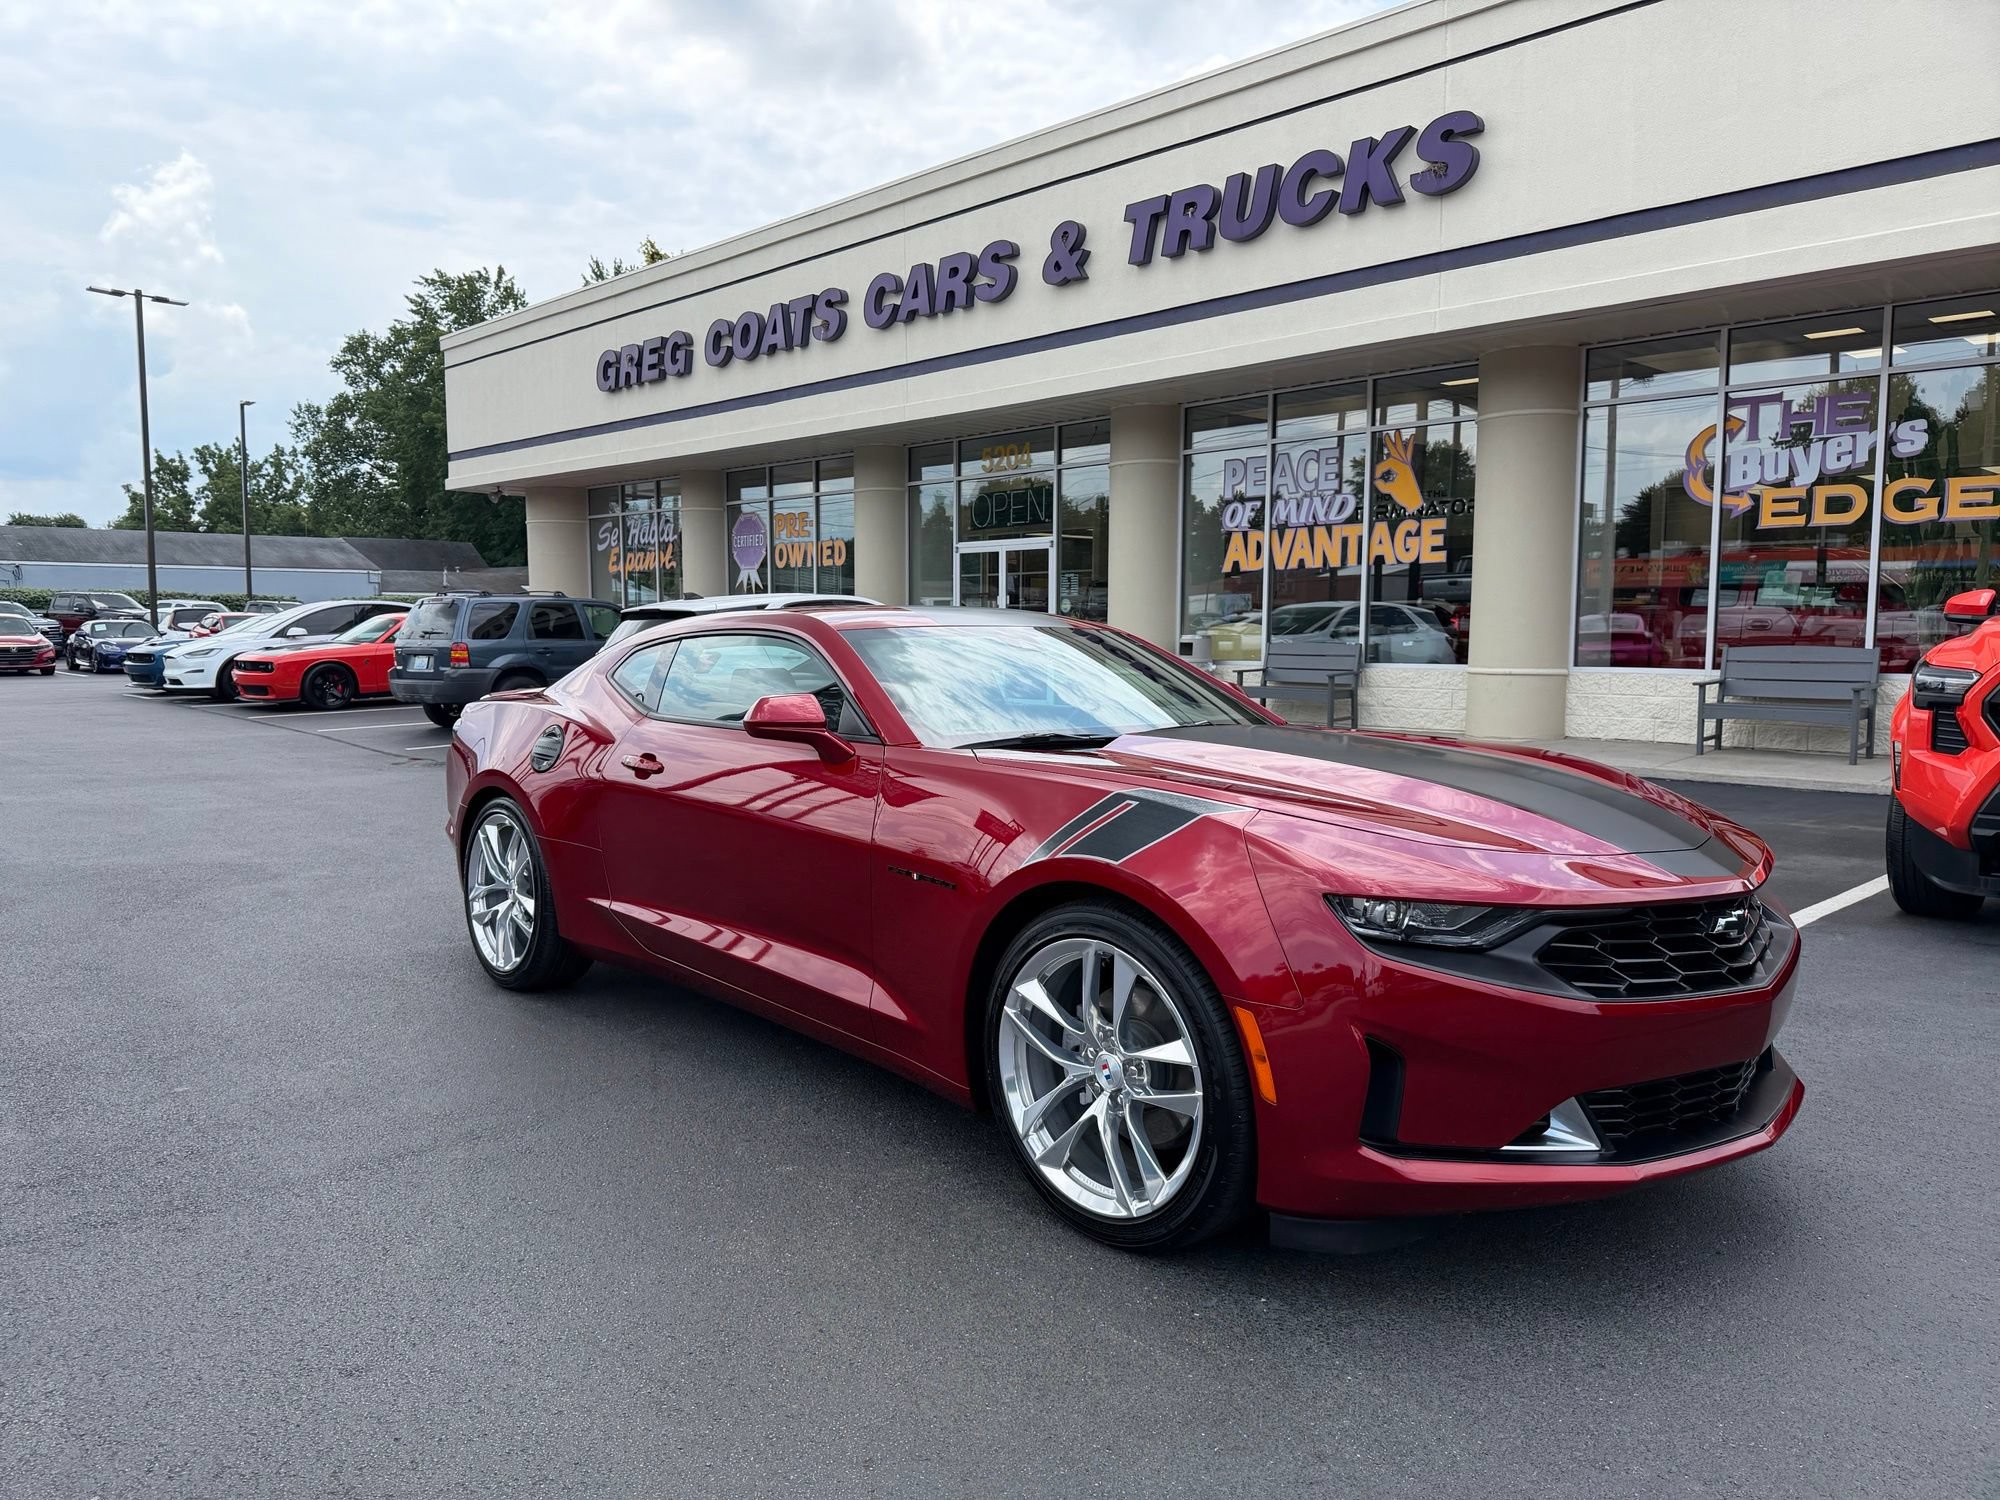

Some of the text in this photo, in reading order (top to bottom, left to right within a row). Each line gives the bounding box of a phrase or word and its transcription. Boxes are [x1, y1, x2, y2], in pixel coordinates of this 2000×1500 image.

[597, 110, 1485, 392] GREG COATS CARS & TRUCKS
[1727, 390, 1872, 444] THE
[981, 442, 1032, 473] 5204
[1223, 447, 1340, 500] PEACE
[1726, 418, 1929, 492] Buyer's
[972, 487, 1046, 528] OPEN
[1222, 494, 1357, 531] OF MIND
[1757, 475, 2000, 530] EDGE
[597, 514, 677, 552] Se Habla
[733, 534, 764, 548] CERTIFIED
[774, 512, 814, 539] PRE-
[1221, 517, 1448, 573] ADVANTAGE
[608, 543, 677, 580] Epañl
[774, 538, 847, 569] OWNED
